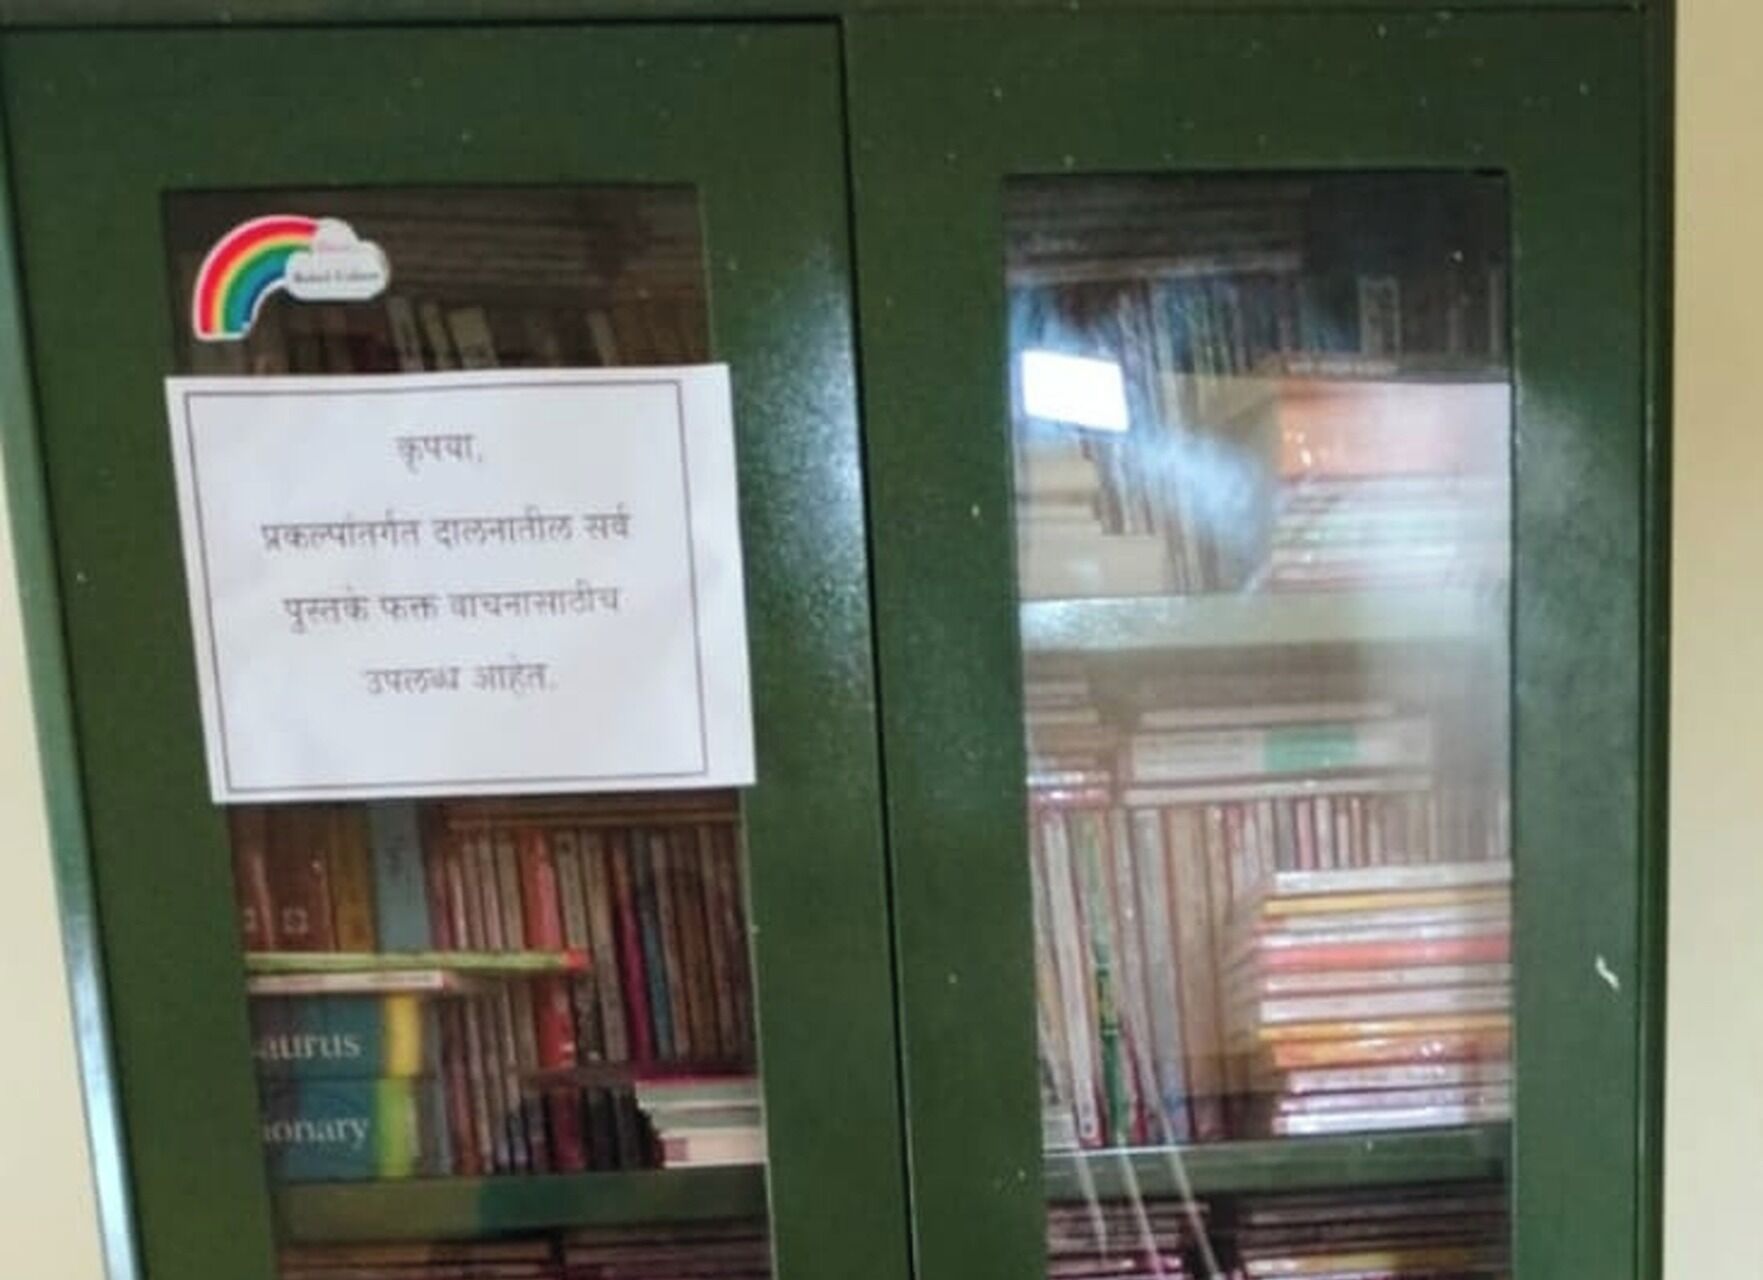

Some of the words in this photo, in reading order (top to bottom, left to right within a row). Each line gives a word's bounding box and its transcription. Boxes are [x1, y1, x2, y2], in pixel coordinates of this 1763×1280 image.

[431, 505, 573, 550] दालनातील
[583, 503, 633, 541] सर्व
[281, 584, 371, 635] पुस्तके
[378, 593, 441, 622] फक्त
[449, 578, 619, 621] वाचनासाठीच
[364, 665, 461, 696] उपलब्ध
